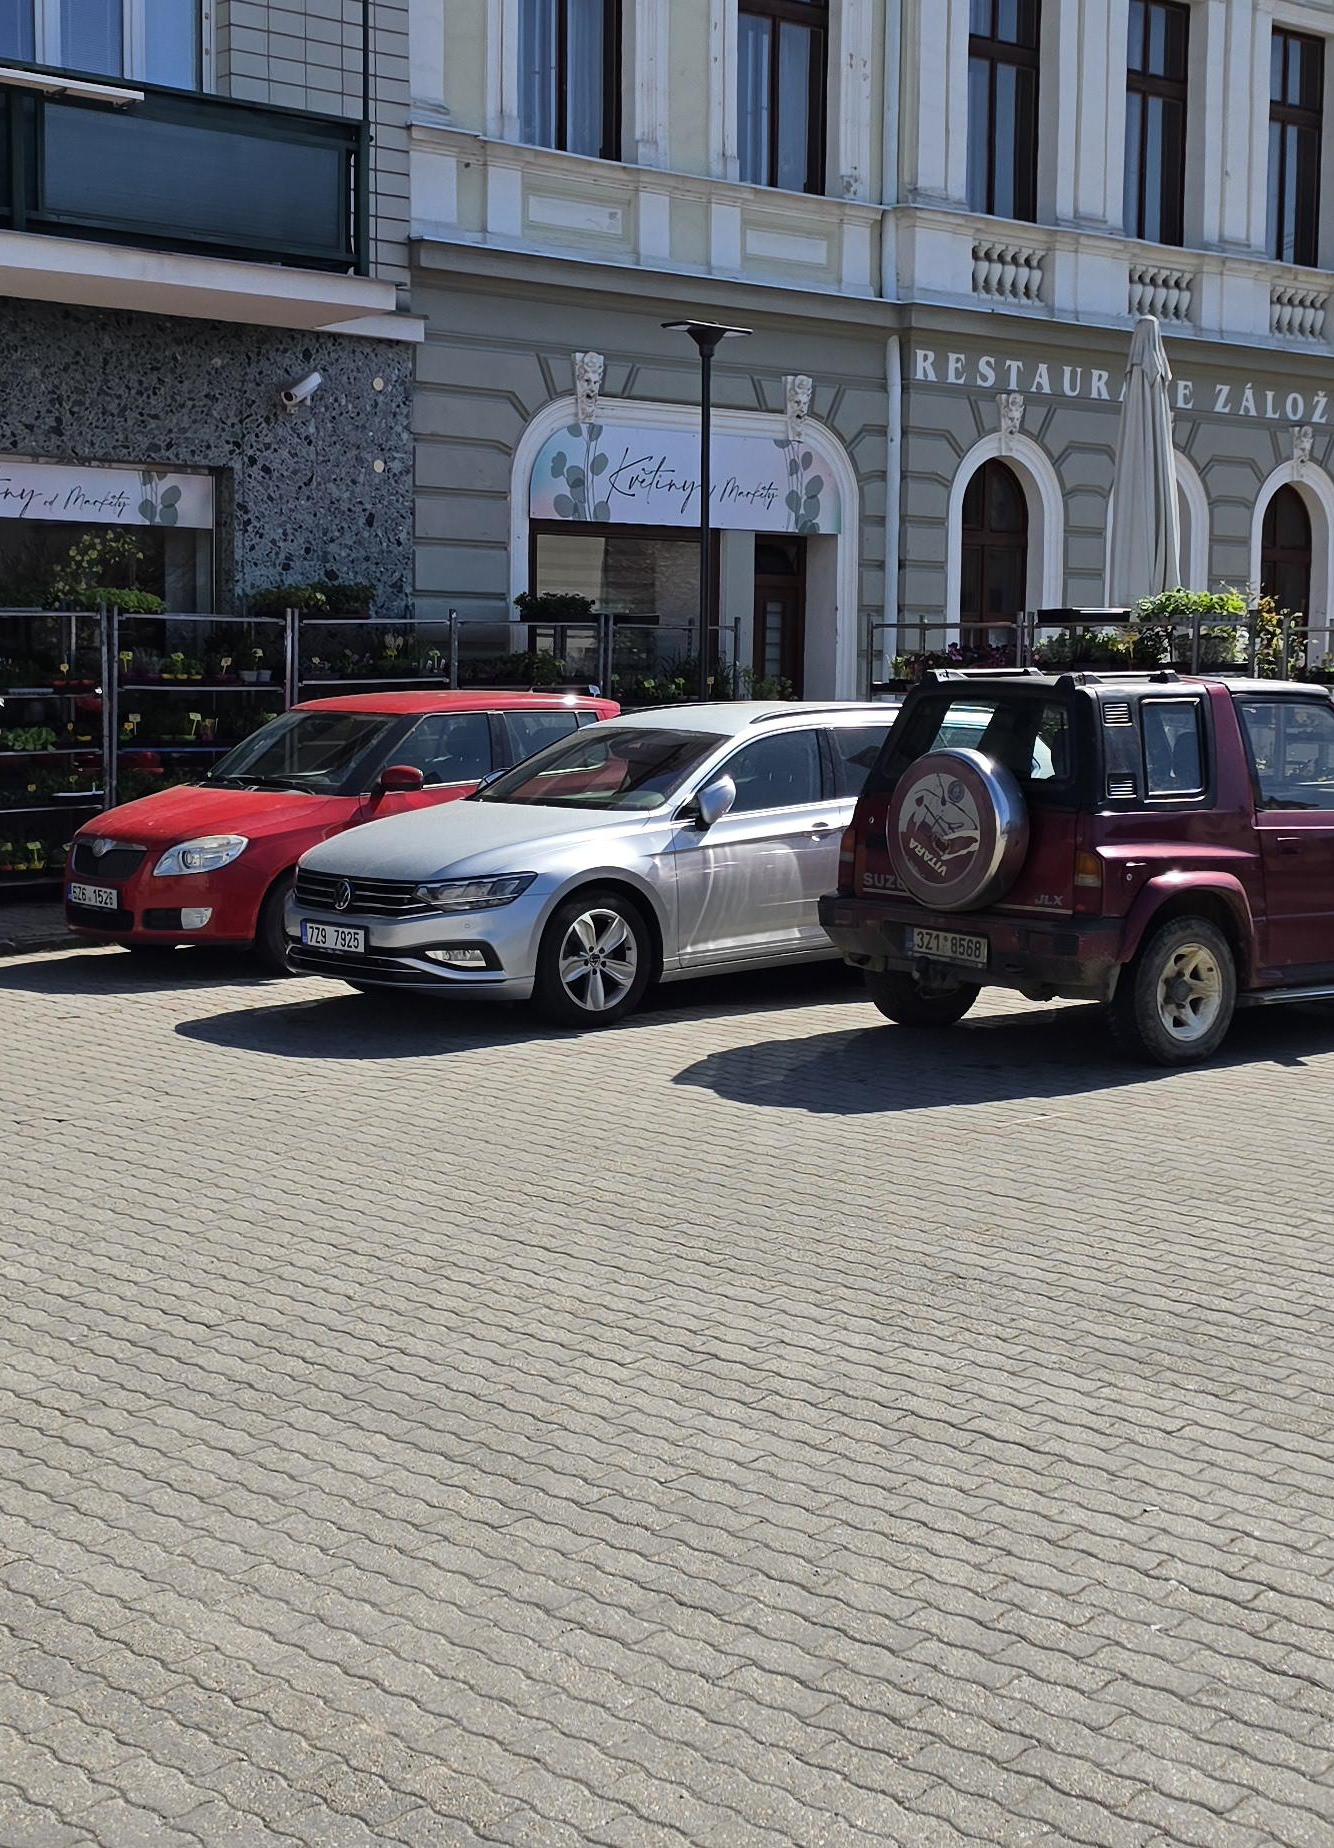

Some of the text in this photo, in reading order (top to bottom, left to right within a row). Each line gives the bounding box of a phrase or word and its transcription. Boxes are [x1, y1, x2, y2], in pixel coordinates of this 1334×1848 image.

[914, 348, 1195, 410] RESTAURE
[605, 447, 780, 515] Květiny Markéty
[63, 485, 132, 518] Markéty
[909, 838, 948, 877] VITARA
[1034, 894, 1063, 906] JLX
[308, 925, 360, 949] 7Z9 7925
[916, 930, 982, 958] 3Z1 8568
